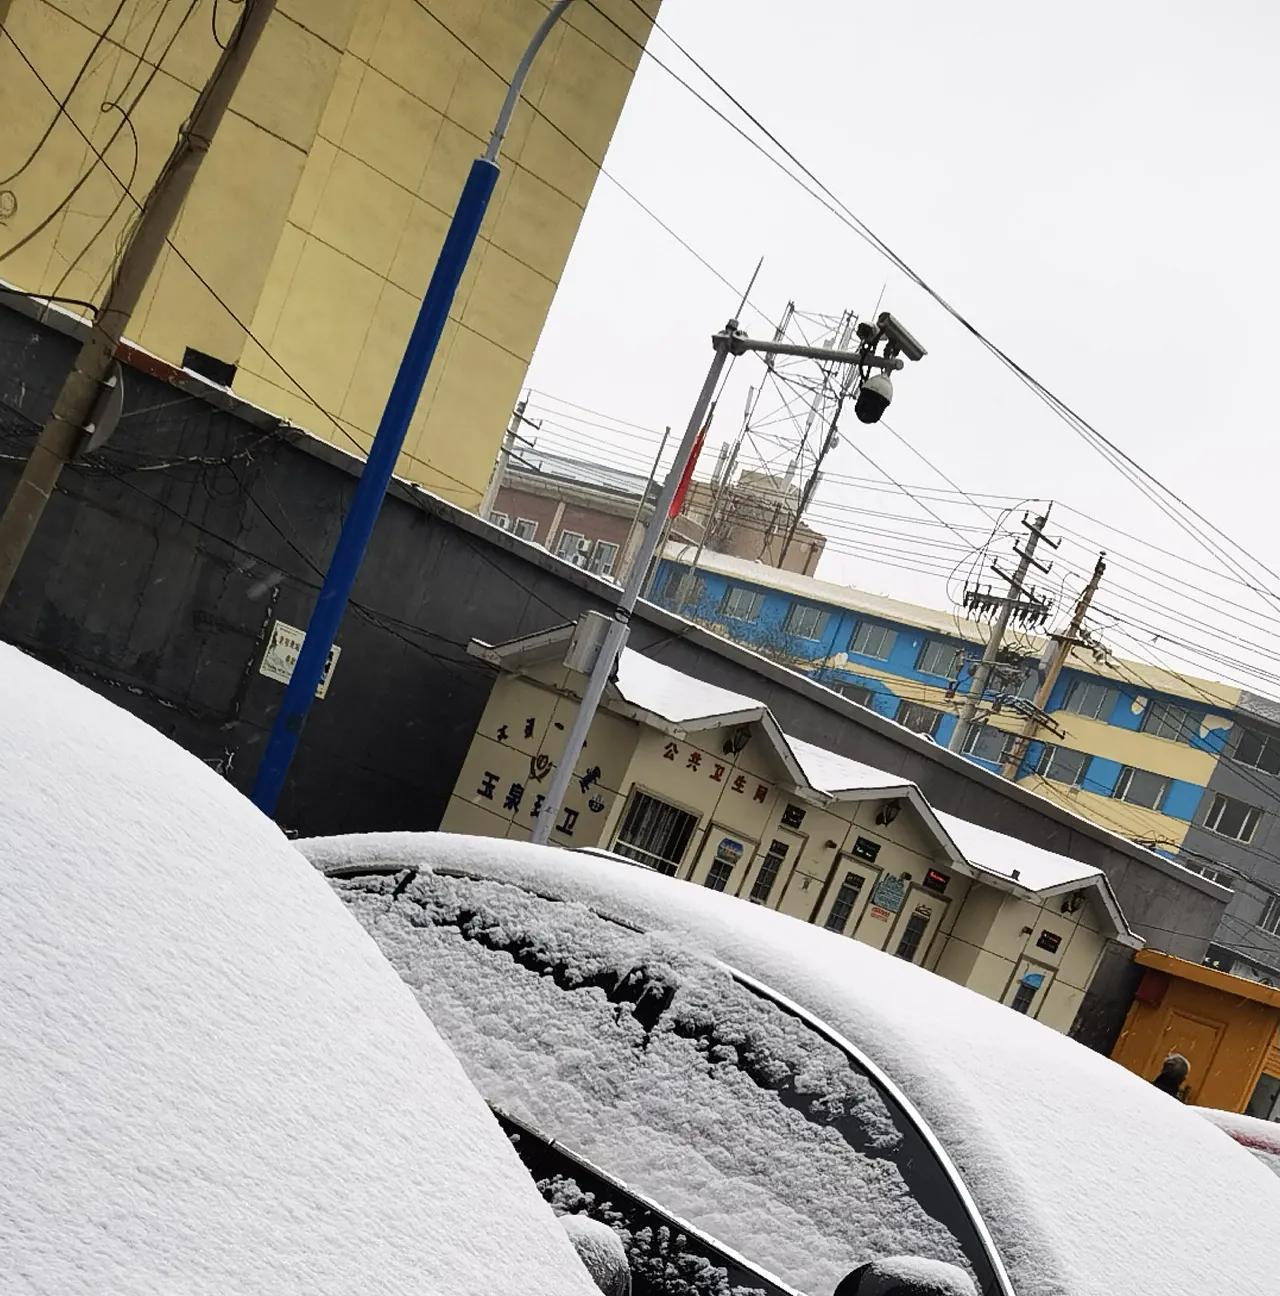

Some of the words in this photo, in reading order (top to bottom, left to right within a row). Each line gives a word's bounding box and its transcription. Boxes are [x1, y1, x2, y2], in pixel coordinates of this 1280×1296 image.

[663, 742, 769, 803] 公共卫生间
